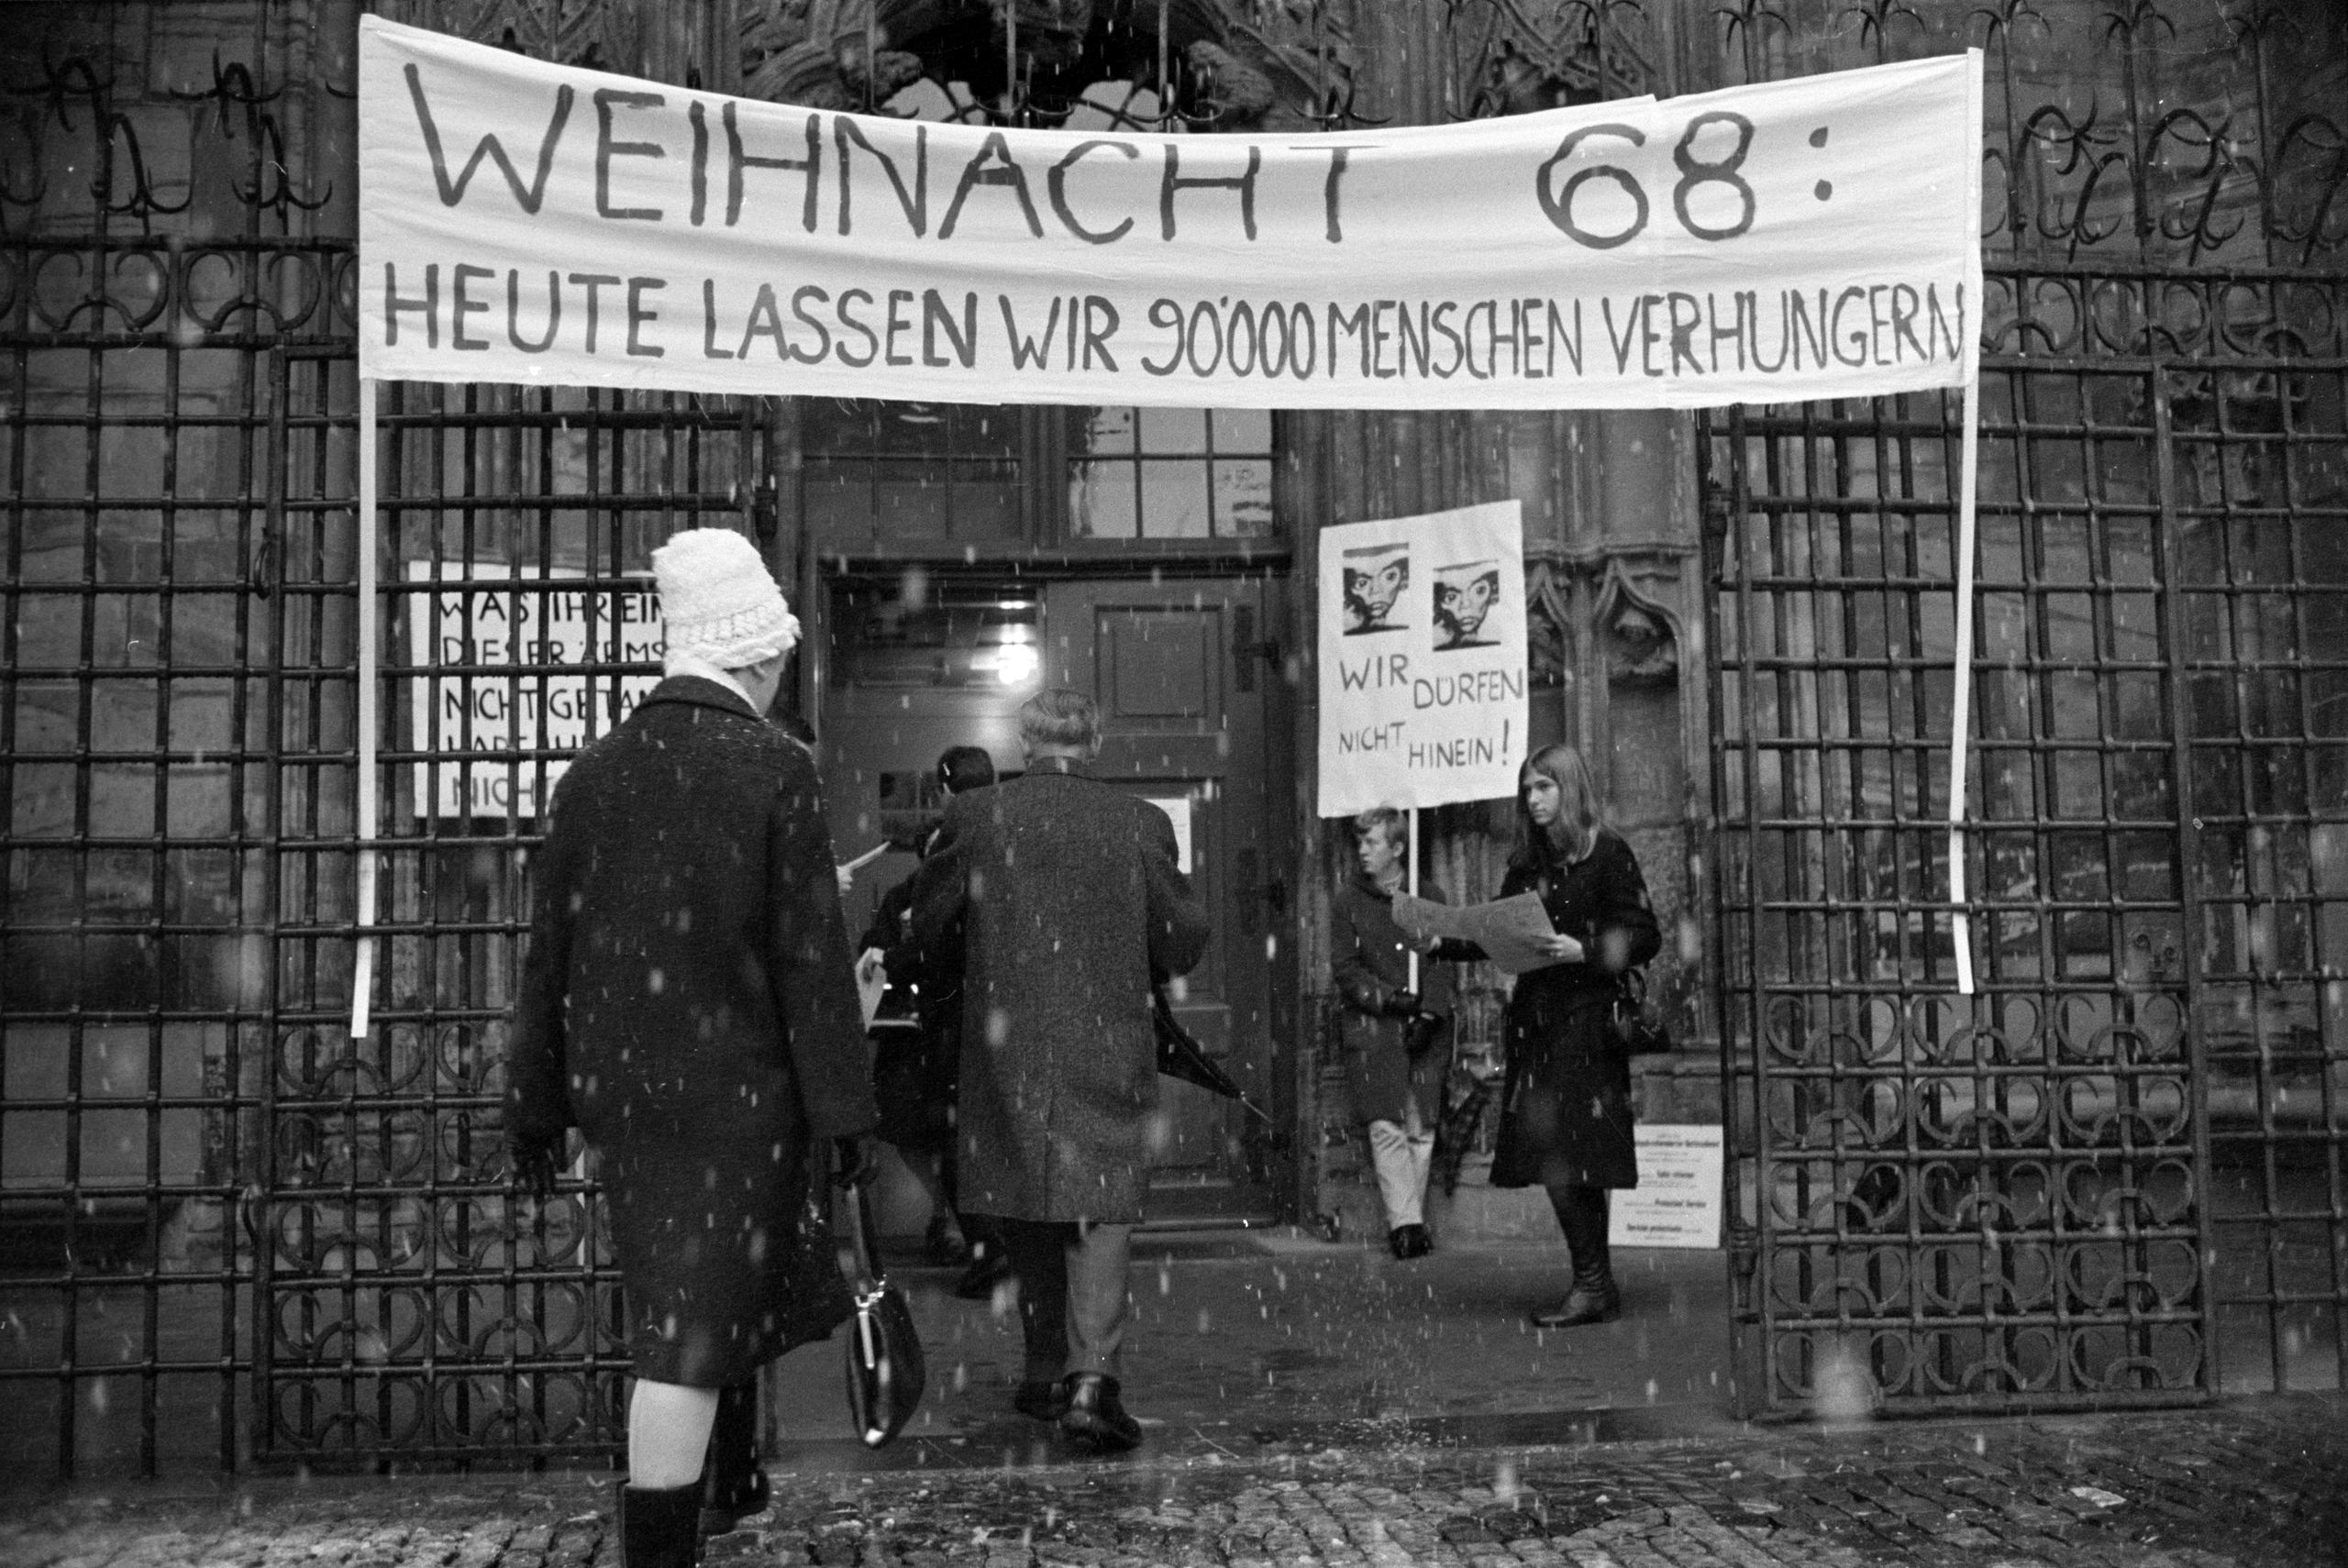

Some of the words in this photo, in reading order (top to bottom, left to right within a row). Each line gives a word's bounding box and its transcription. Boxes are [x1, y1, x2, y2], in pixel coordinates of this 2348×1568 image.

[404, 62, 1385, 244] WEIHNACHT
[383, 262, 667, 358] HEUTE
[703, 279, 978, 370] LASSEN
[999, 293, 1119, 371] WIR
[1327, 297, 1582, 381] MENSCHEN
[1601, 282, 1964, 378] VERHUNGERN
[548, 688, 650, 720] GETA
[1340, 654, 1409, 690] WIR
[1413, 668, 1523, 710] DÜRFEN
[1338, 721, 1406, 754] NICHT
